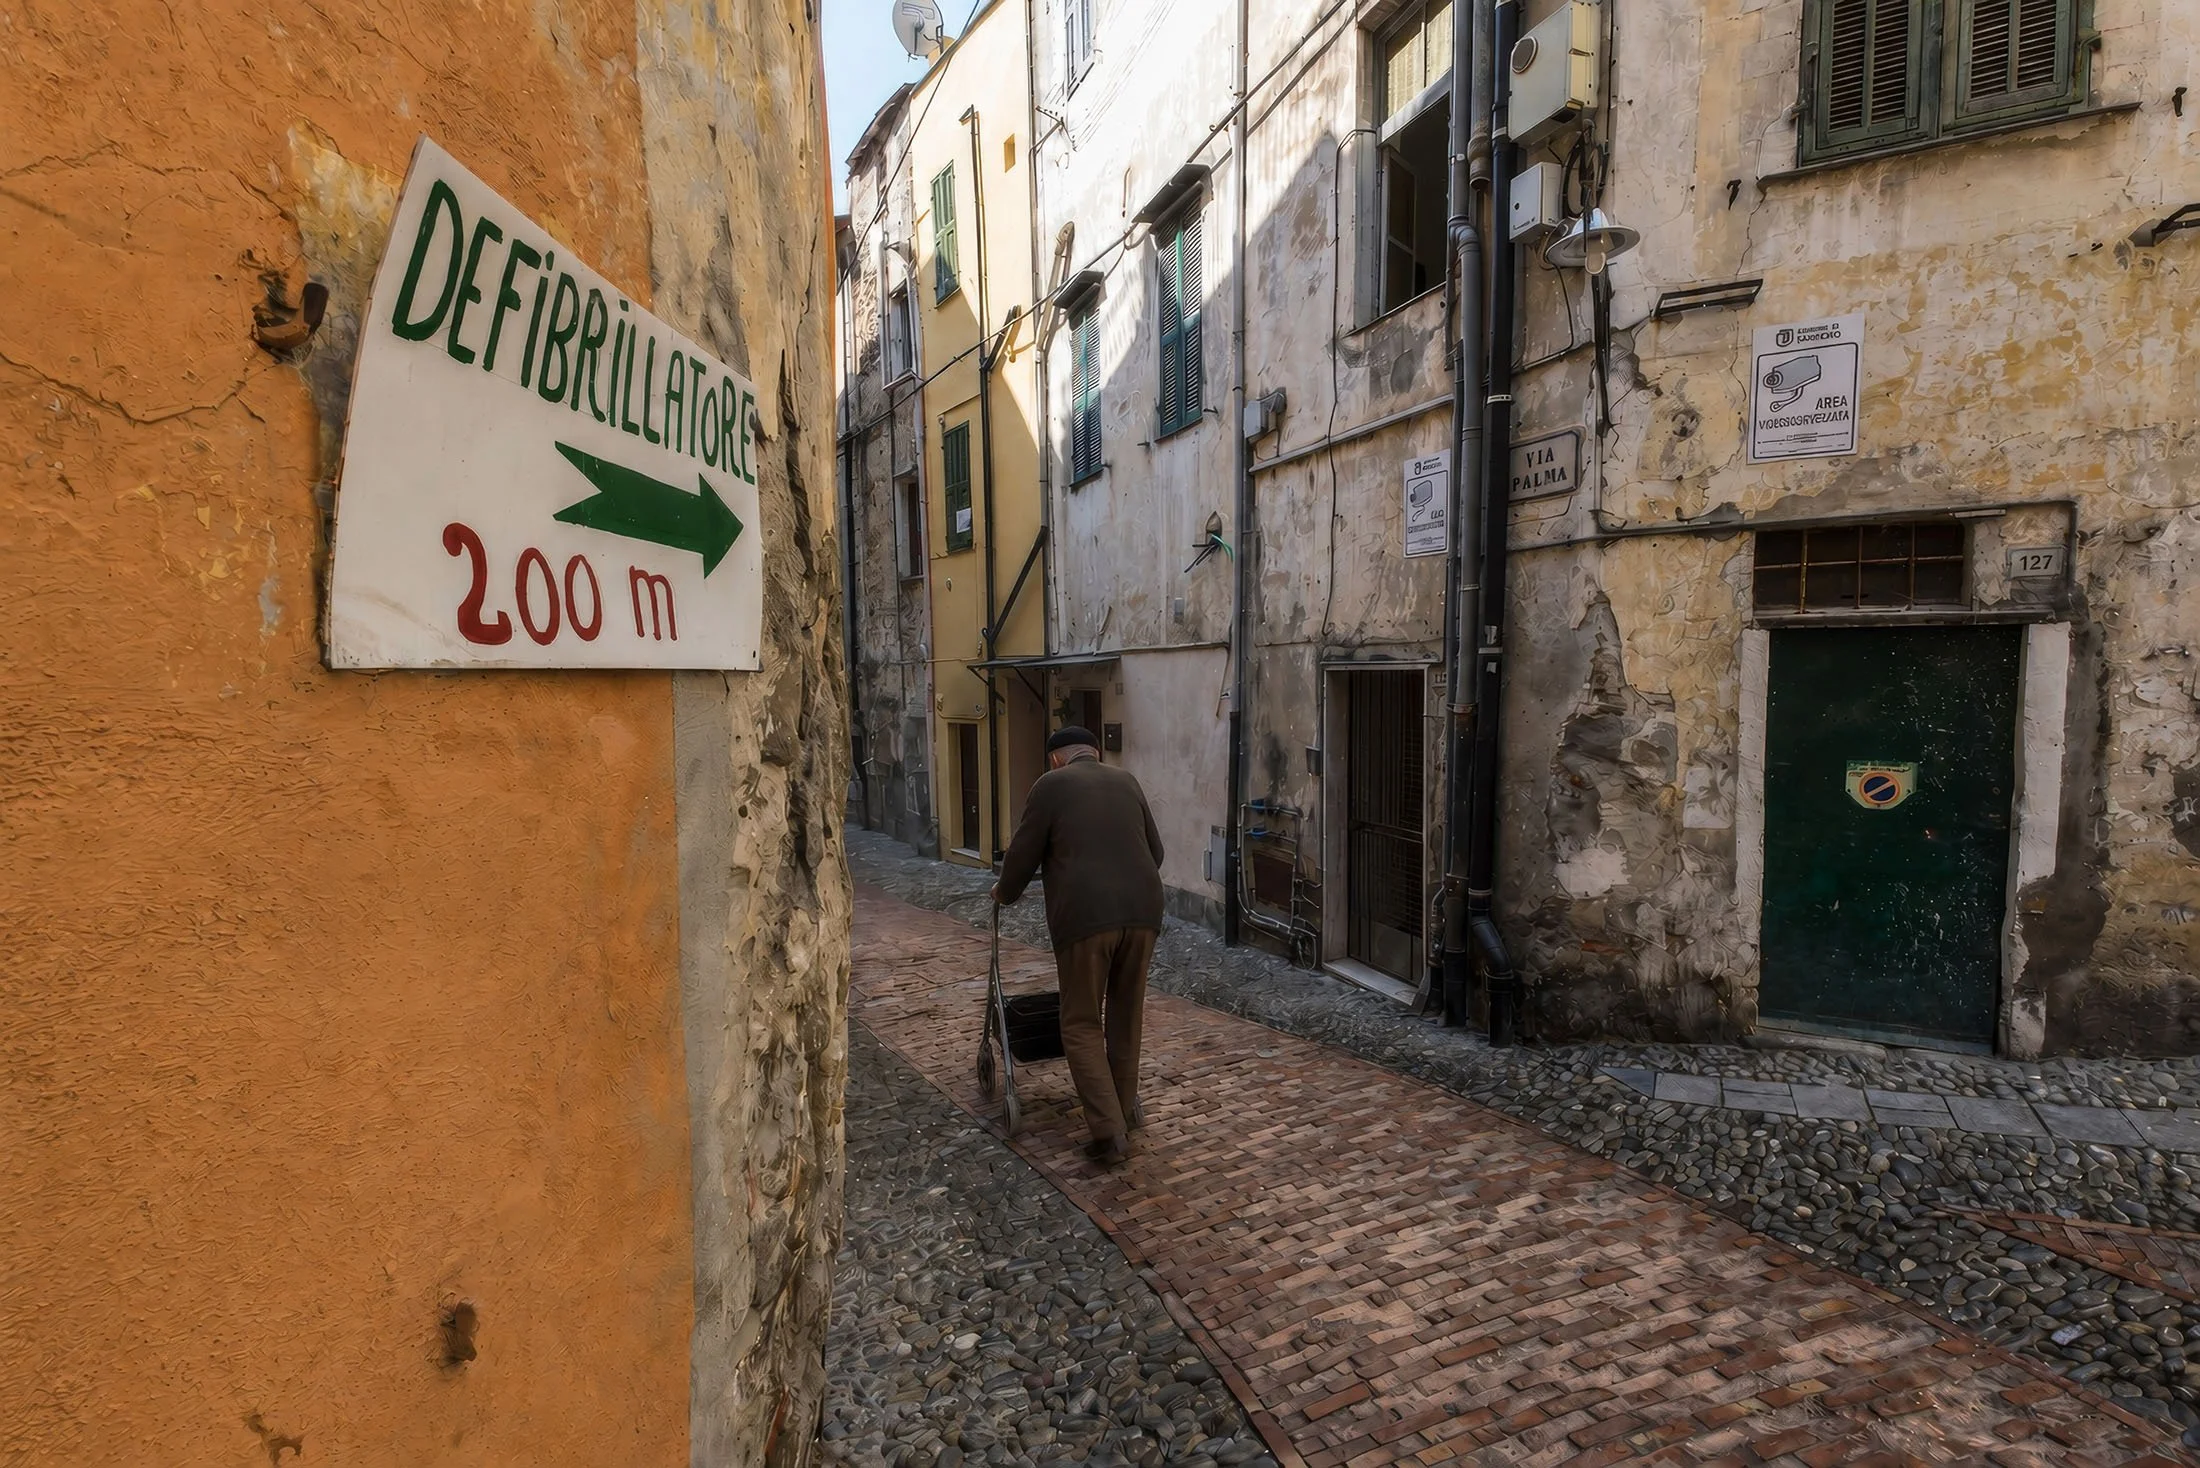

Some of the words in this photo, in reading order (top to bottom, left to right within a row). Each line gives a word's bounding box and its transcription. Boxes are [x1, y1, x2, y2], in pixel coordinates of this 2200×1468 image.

[1815, 396, 1848, 411] AREA
[1525, 447, 1555, 468] VIA
[1512, 467, 1568, 492] PALMA
[2019, 554, 2054, 571] 127
[441, 521, 604, 646] 200
[629, 564, 678, 641] m
